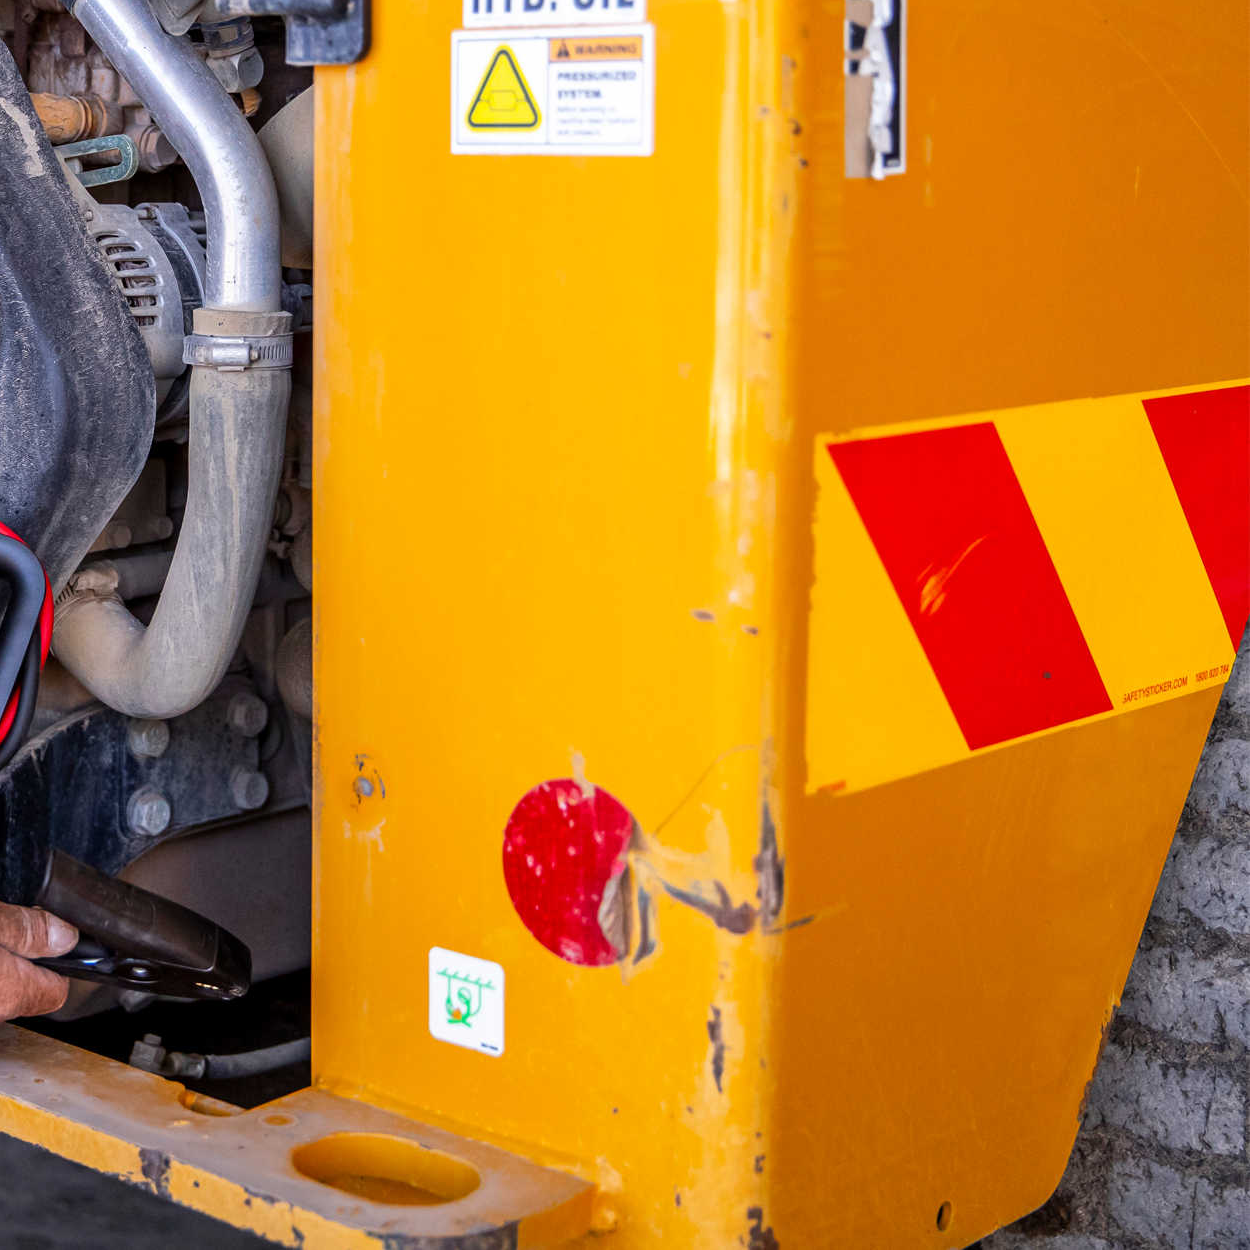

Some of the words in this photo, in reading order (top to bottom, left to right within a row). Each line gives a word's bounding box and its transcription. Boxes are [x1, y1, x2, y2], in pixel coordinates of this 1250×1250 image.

[575, 43, 637, 55] WARNING
[557, 70, 637, 82] PRESSURIZED
[1122, 676, 1188, 704] SAFETYSTICKER.COM
